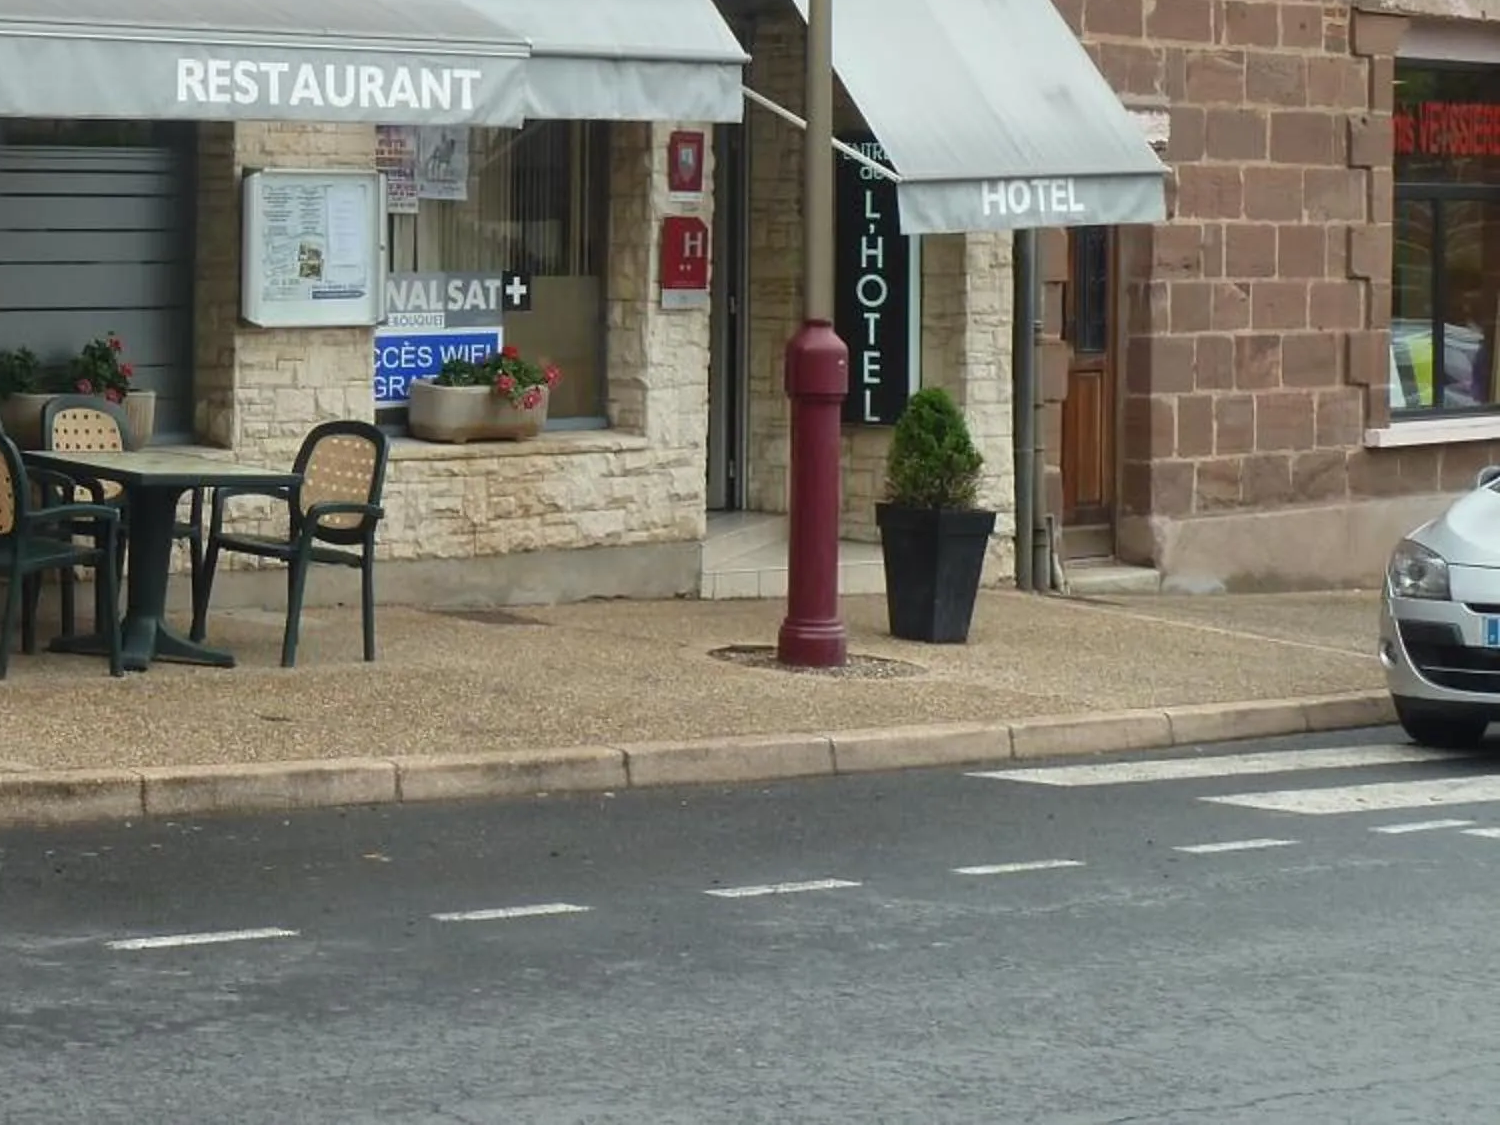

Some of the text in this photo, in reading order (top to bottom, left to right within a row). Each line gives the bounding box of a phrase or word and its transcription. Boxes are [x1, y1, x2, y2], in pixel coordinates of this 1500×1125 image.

[176, 58, 482, 111] RESTAURANT
[980, 177, 1086, 216] HOTEL
[682, 231, 703, 258] H
[386, 278, 501, 311] NALSAT
